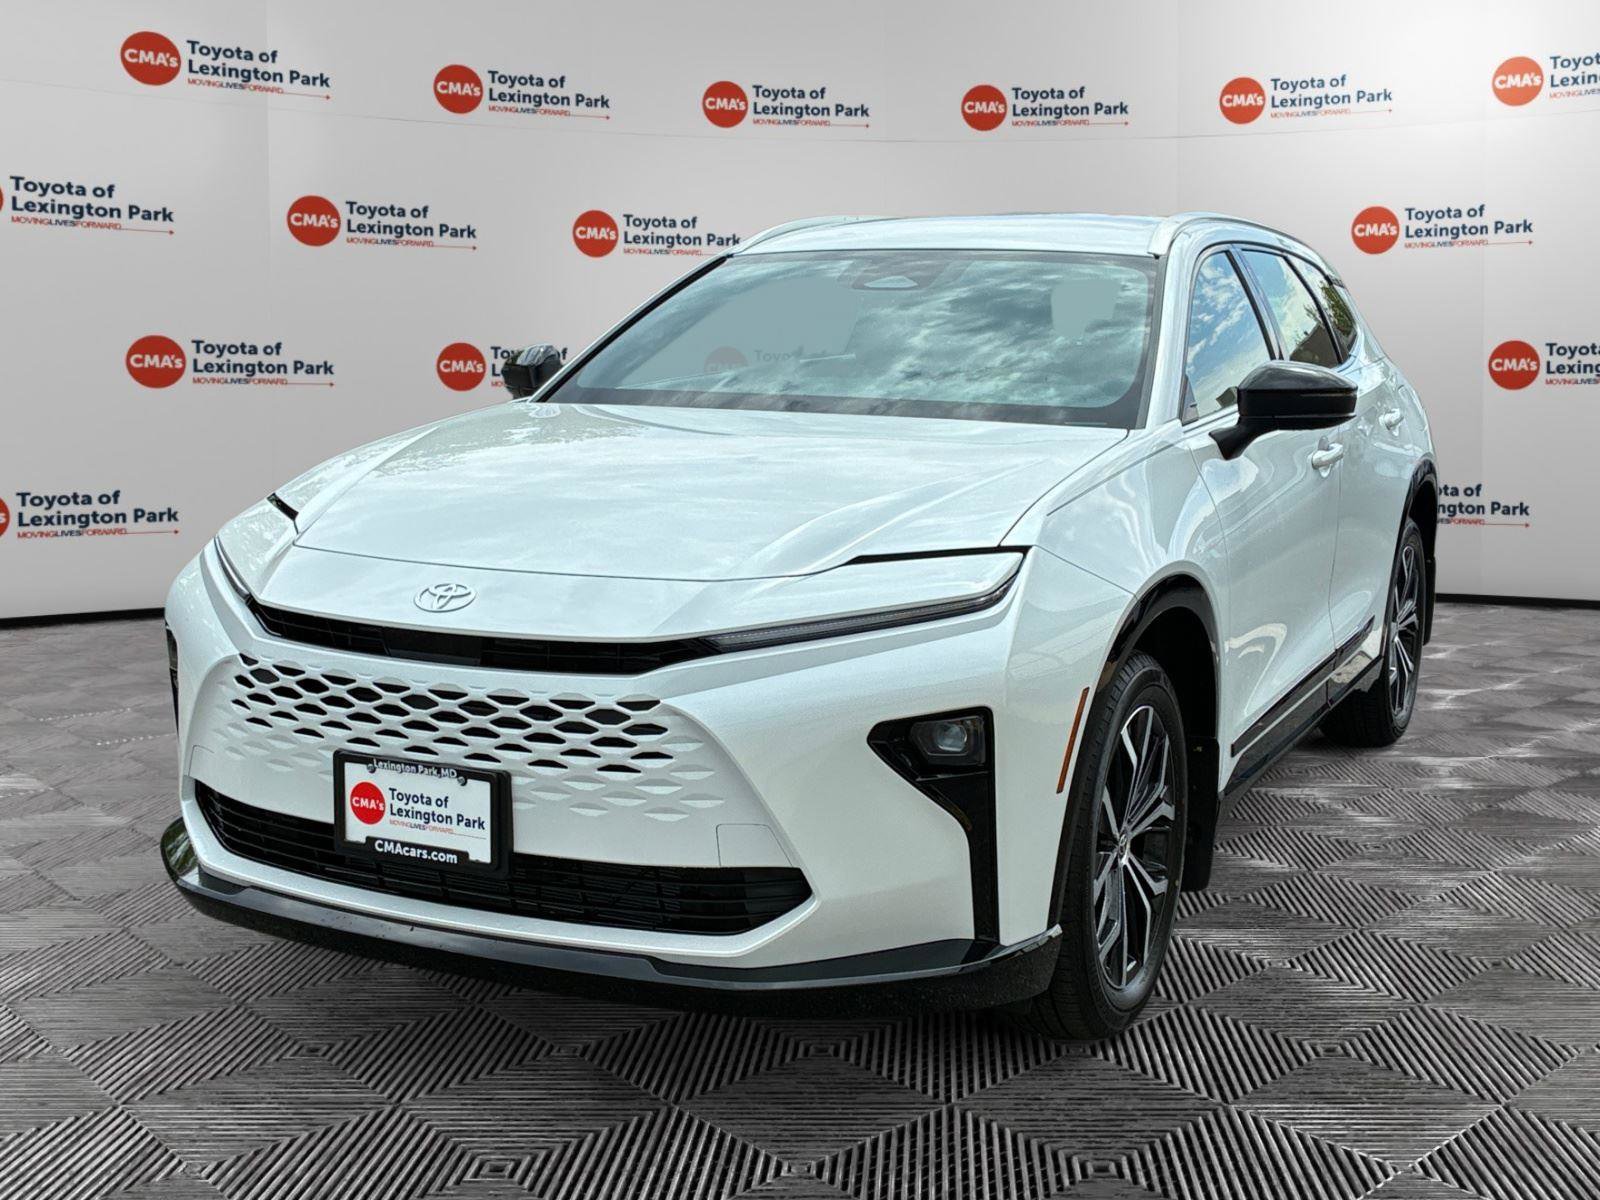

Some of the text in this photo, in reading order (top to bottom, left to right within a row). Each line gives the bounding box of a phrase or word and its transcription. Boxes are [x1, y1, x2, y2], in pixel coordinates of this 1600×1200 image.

[124, 49, 178, 67] CMA's
[187, 40, 278, 63] Toyota of
[1550, 52, 1600, 71] Toyot
[188, 60, 330, 88] Lexington Park
[488, 71, 565, 88] Toyota of
[1494, 72, 1541, 89] CMA's
[1550, 71, 1600, 87] Lexin
[437, 81, 481, 96] CMA's
[1271, 74, 1347, 93] Toyota of
[489, 89, 610, 108] Lexington Park
[753, 85, 826, 101] Toyota of
[1012, 87, 1085, 102] Toyota of
[1222, 94, 1263, 107] CMA's
[1271, 89, 1392, 109] Lexington Park
[705, 98, 746, 110] CMA's
[753, 102, 869, 118] Lexington Park
[964, 101, 1005, 113] CMA's
[1012, 102, 1128, 119] Lexington Park
[10, 176, 115, 198] Toyota of
[11, 196, 174, 222] Lexington Park
[346, 201, 429, 219] Toyota of
[1405, 204, 1485, 223] Toyota of
[290, 213, 338, 228] CMA's
[347, 220, 476, 238] Lexington Park
[623, 214, 697, 230] Toyota of
[575, 227, 616, 240] CMA's
[1354, 223, 1397, 236] CMA's
[1405, 219, 1533, 240] Lexington Park
[624, 232, 741, 248] Lexington Park
[192, 340, 282, 357] Toyota of
[1546, 343, 1600, 359] Toyot
[130, 354, 183, 369] CMA's
[193, 359, 334, 376] Lexington Park
[440, 360, 484, 372] CMA's
[1491, 358, 1538, 371] CMA's
[1546, 360, 1600, 377] Lexin
[1464, 484, 1482, 496] of
[17, 490, 120, 510] Toyota of
[18, 511, 127, 528] Lexington
[134, 508, 179, 522] Park
[1438, 502, 1530, 517] ngton Park
[373, 758, 416, 774] Lexington
[352, 797, 384, 810] CMA's
[389, 788, 449, 808] Toyota of
[390, 804, 485, 830] Lexington Park
[375, 840, 458, 863] CMAcars.com
